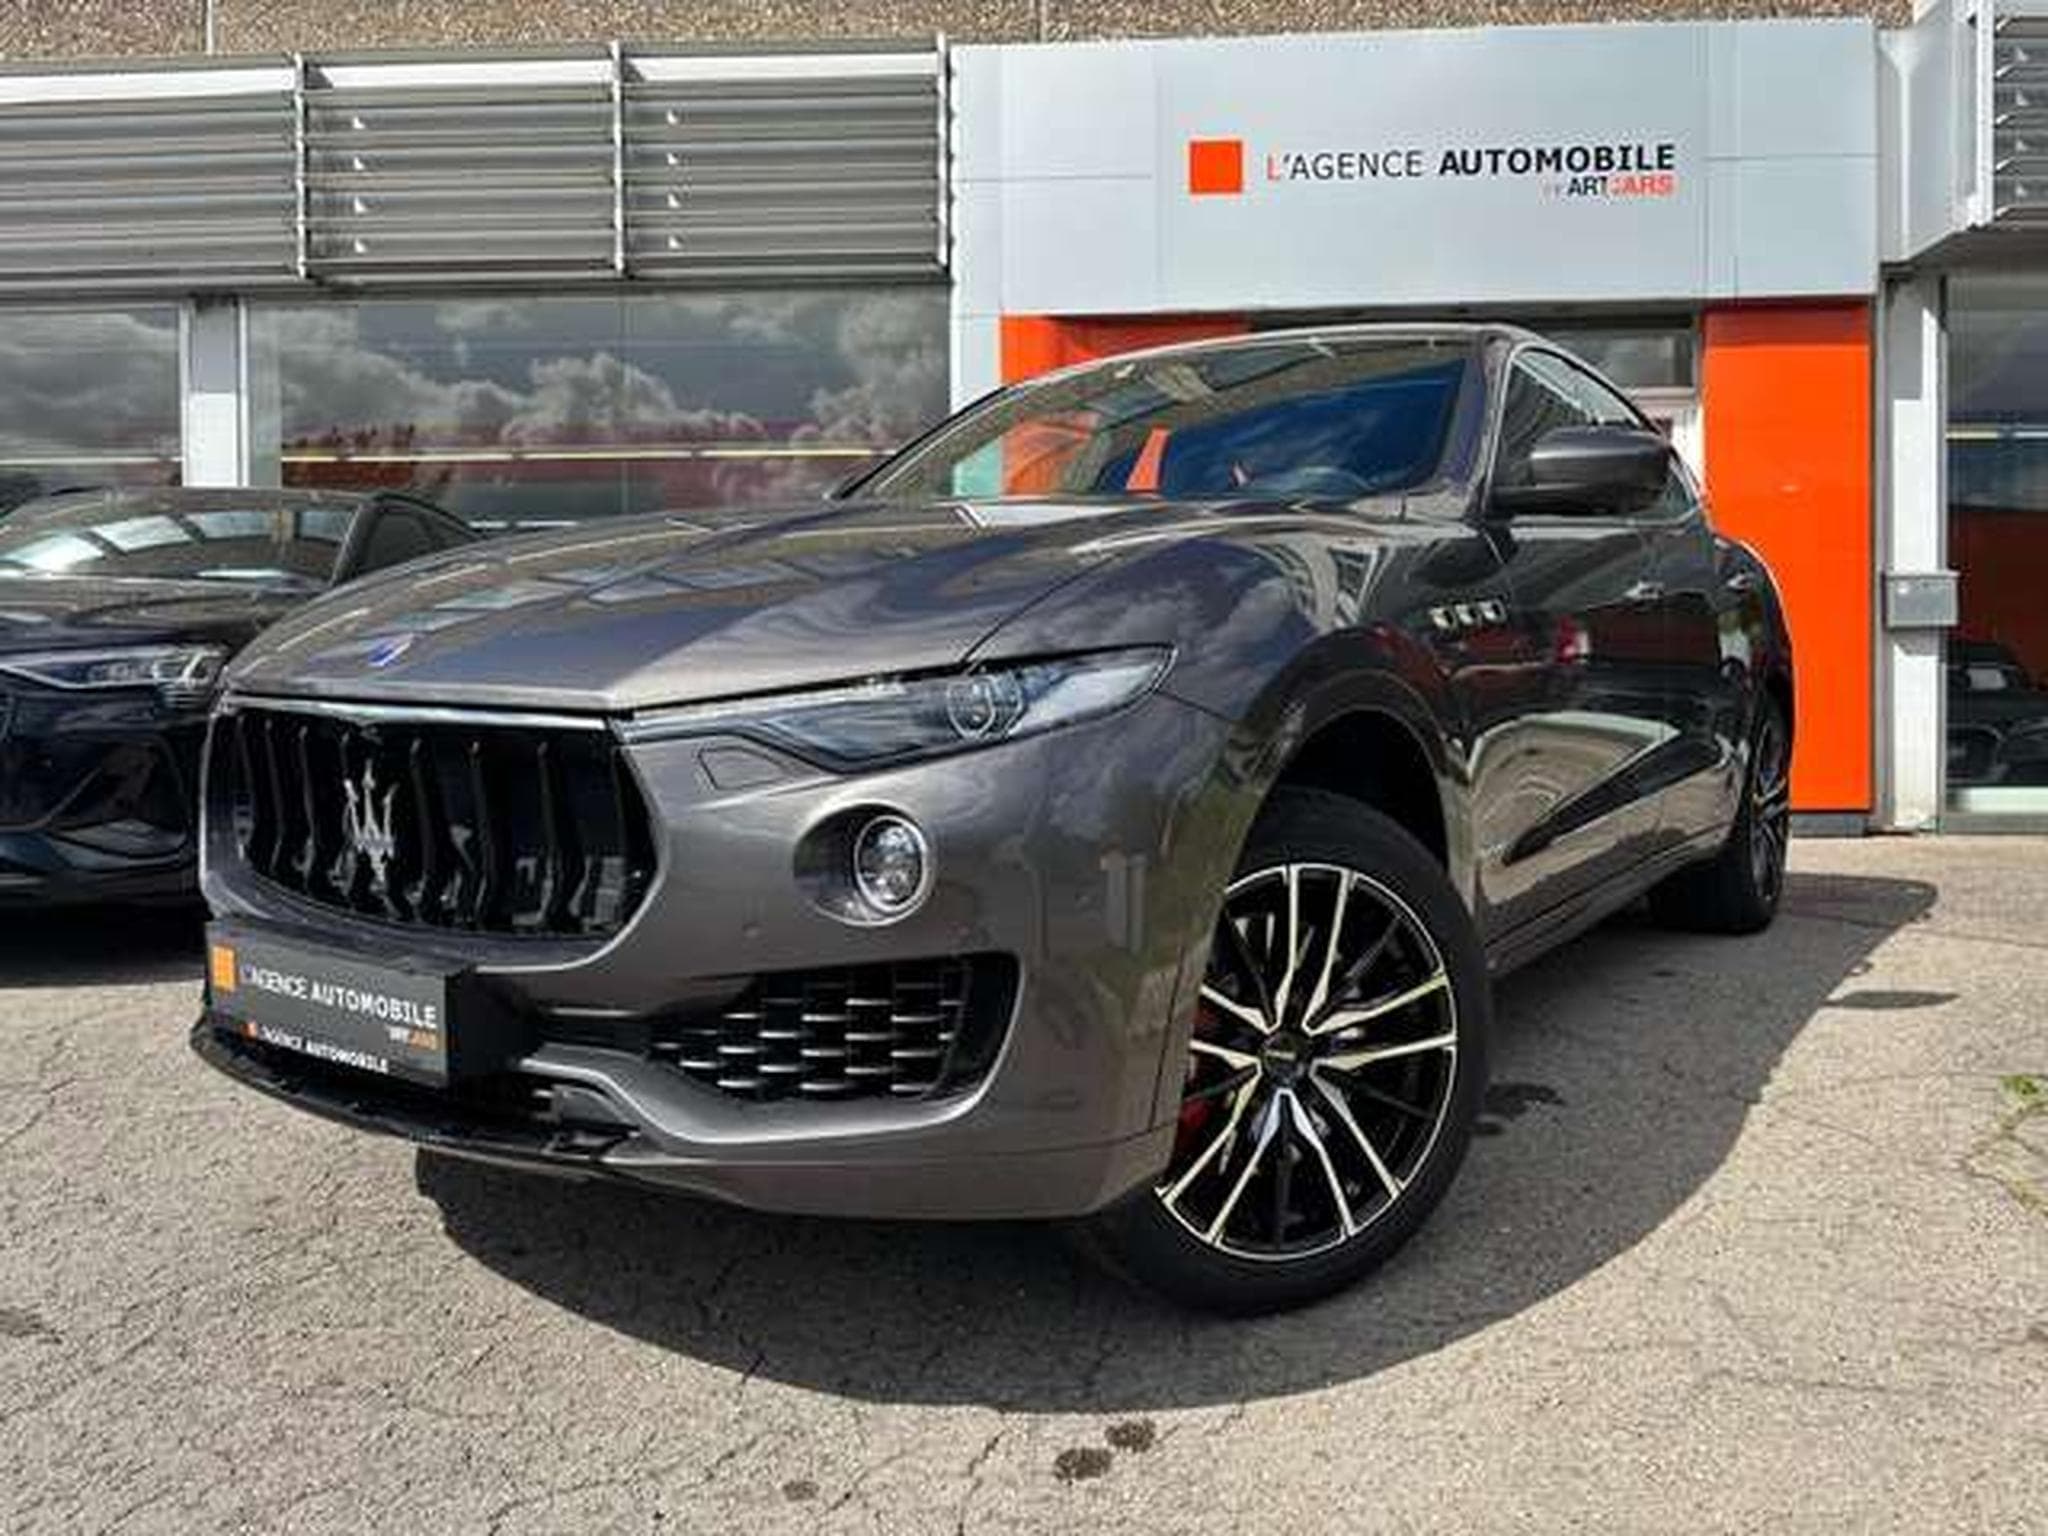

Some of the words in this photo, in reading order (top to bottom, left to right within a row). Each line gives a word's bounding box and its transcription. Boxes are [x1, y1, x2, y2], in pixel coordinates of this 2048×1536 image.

[1266, 149, 1423, 180] L'AGENCE
[1439, 143, 1675, 175] AUTOMOBILE
[310, 980, 437, 1028] AUTOMOBILE
